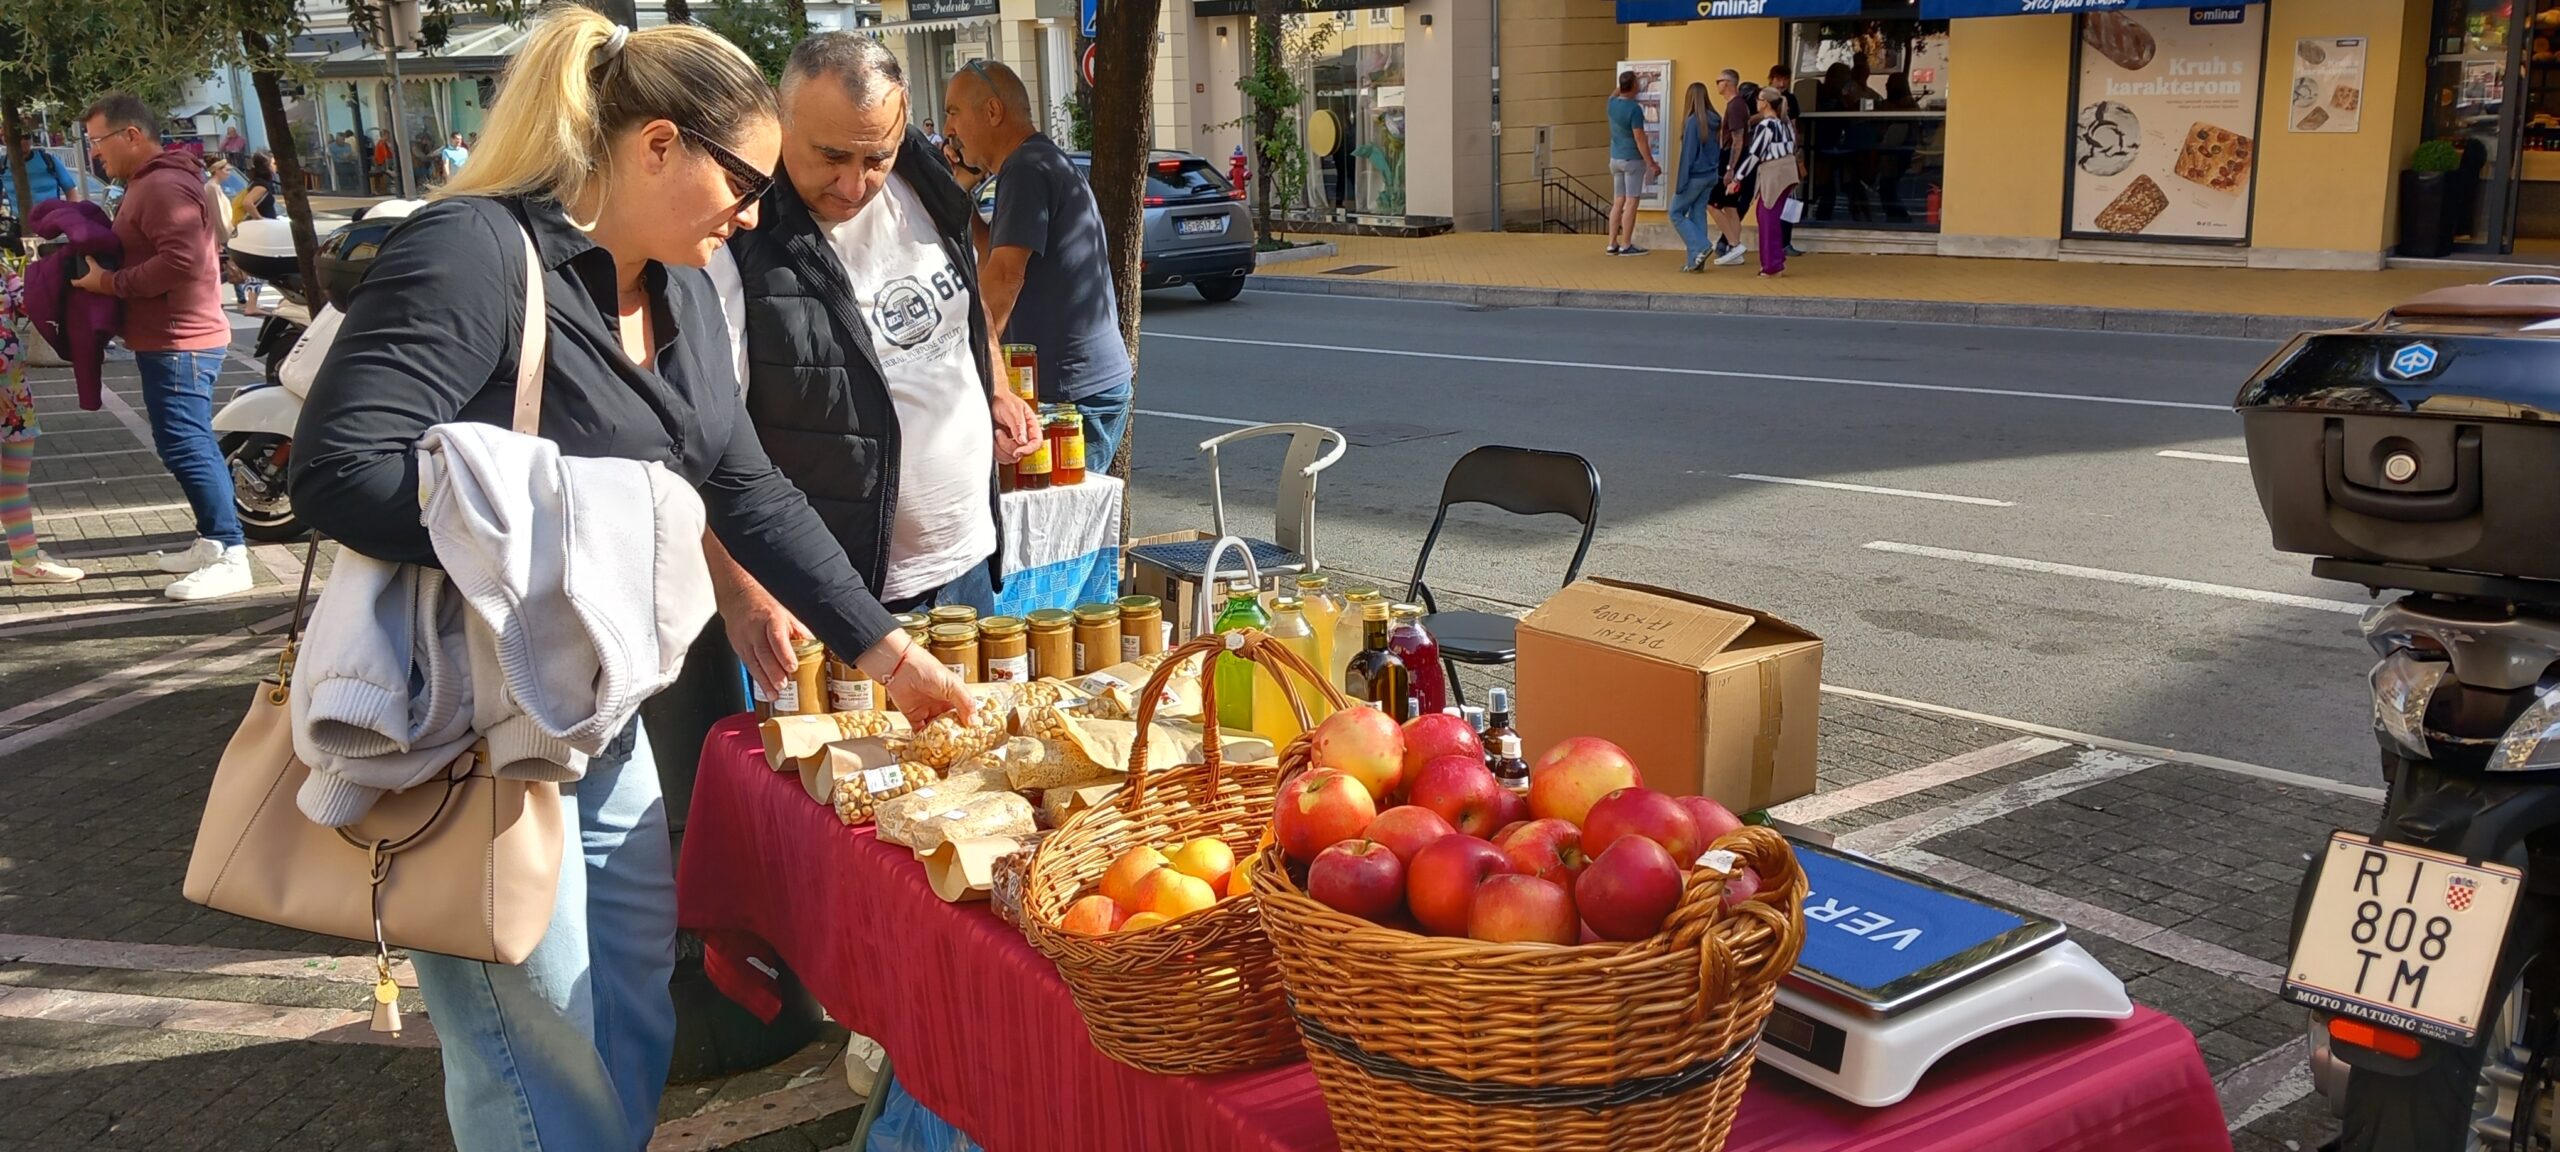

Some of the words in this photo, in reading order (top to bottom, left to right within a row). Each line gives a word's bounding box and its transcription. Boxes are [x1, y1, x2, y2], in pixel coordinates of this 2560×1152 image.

[1711, 0, 1767, 16] mlinar
[2204, 9, 2240, 20] mlinar
[2106, 76, 2241, 96] karakterom
[2169, 56, 2227, 76] Kruh
[2232, 60, 2242, 75] s
[2353, 850, 2425, 904] RI
[1803, 890, 1923, 951] VER
[2351, 900, 2452, 961] 808
[2354, 949, 2430, 1009] TM
[2295, 990, 2341, 1010] MOTO
[2343, 1003, 2417, 1031] MATUŠIĆ
